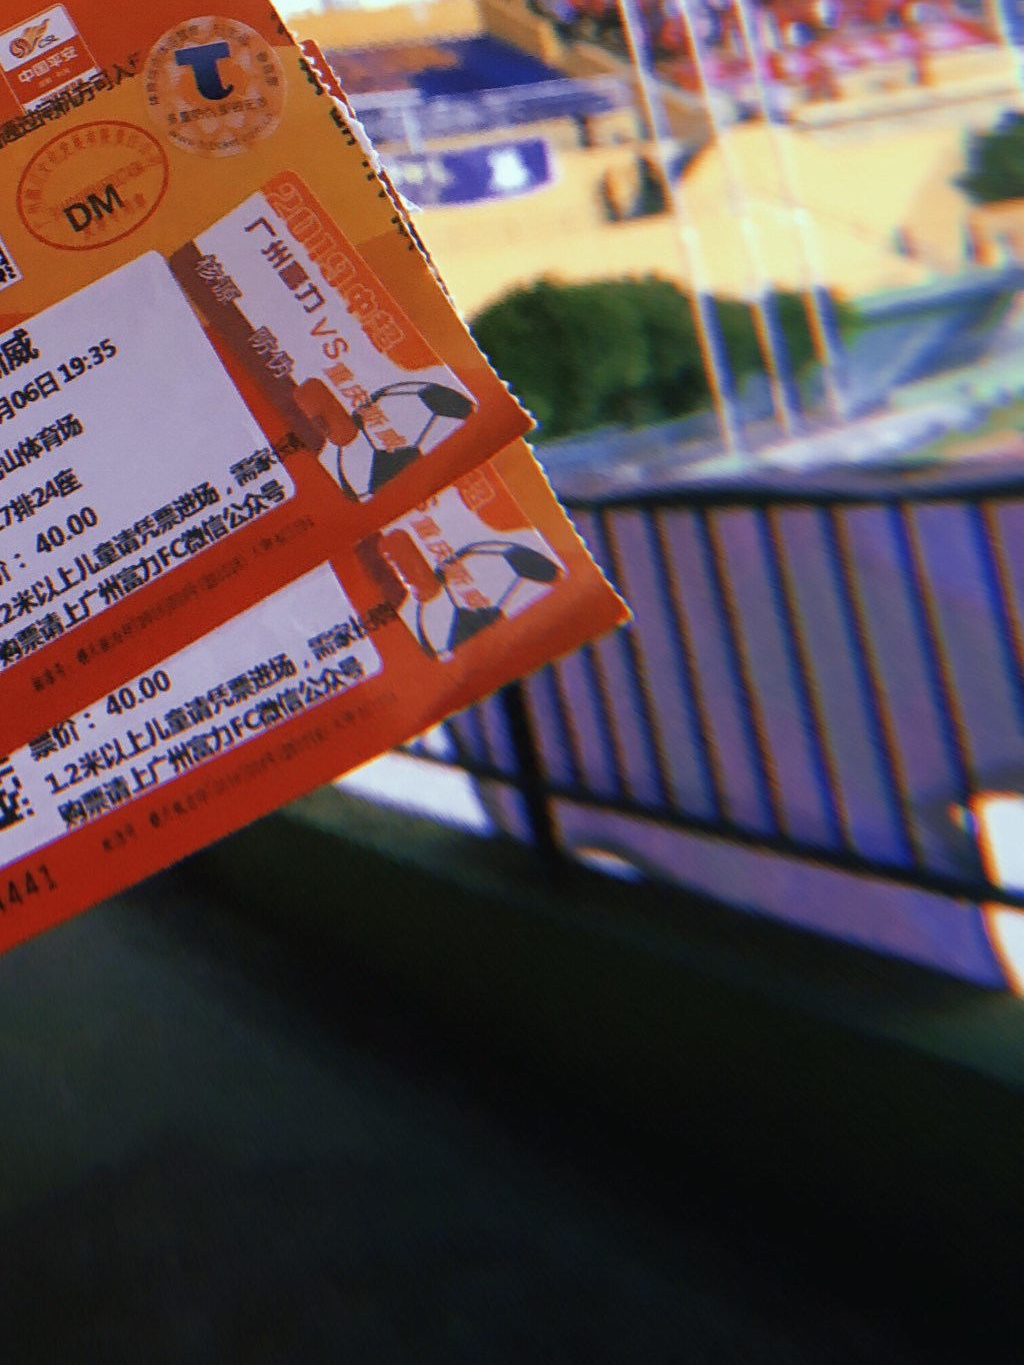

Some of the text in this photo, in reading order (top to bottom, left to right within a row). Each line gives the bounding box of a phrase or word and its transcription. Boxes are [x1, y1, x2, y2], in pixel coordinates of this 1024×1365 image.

[17, 44, 79, 87] 中国平安
[62, 181, 126, 234] DM
[243, 214, 327, 315] 广州富力
[306, 316, 351, 363] VS
[57, 337, 120, 385] 19:35
[30, 504, 100, 557] 40.00
[102, 667, 173, 720] 40.00
[57, 653, 367, 830] 购票请上广州富力FC微信公众号
